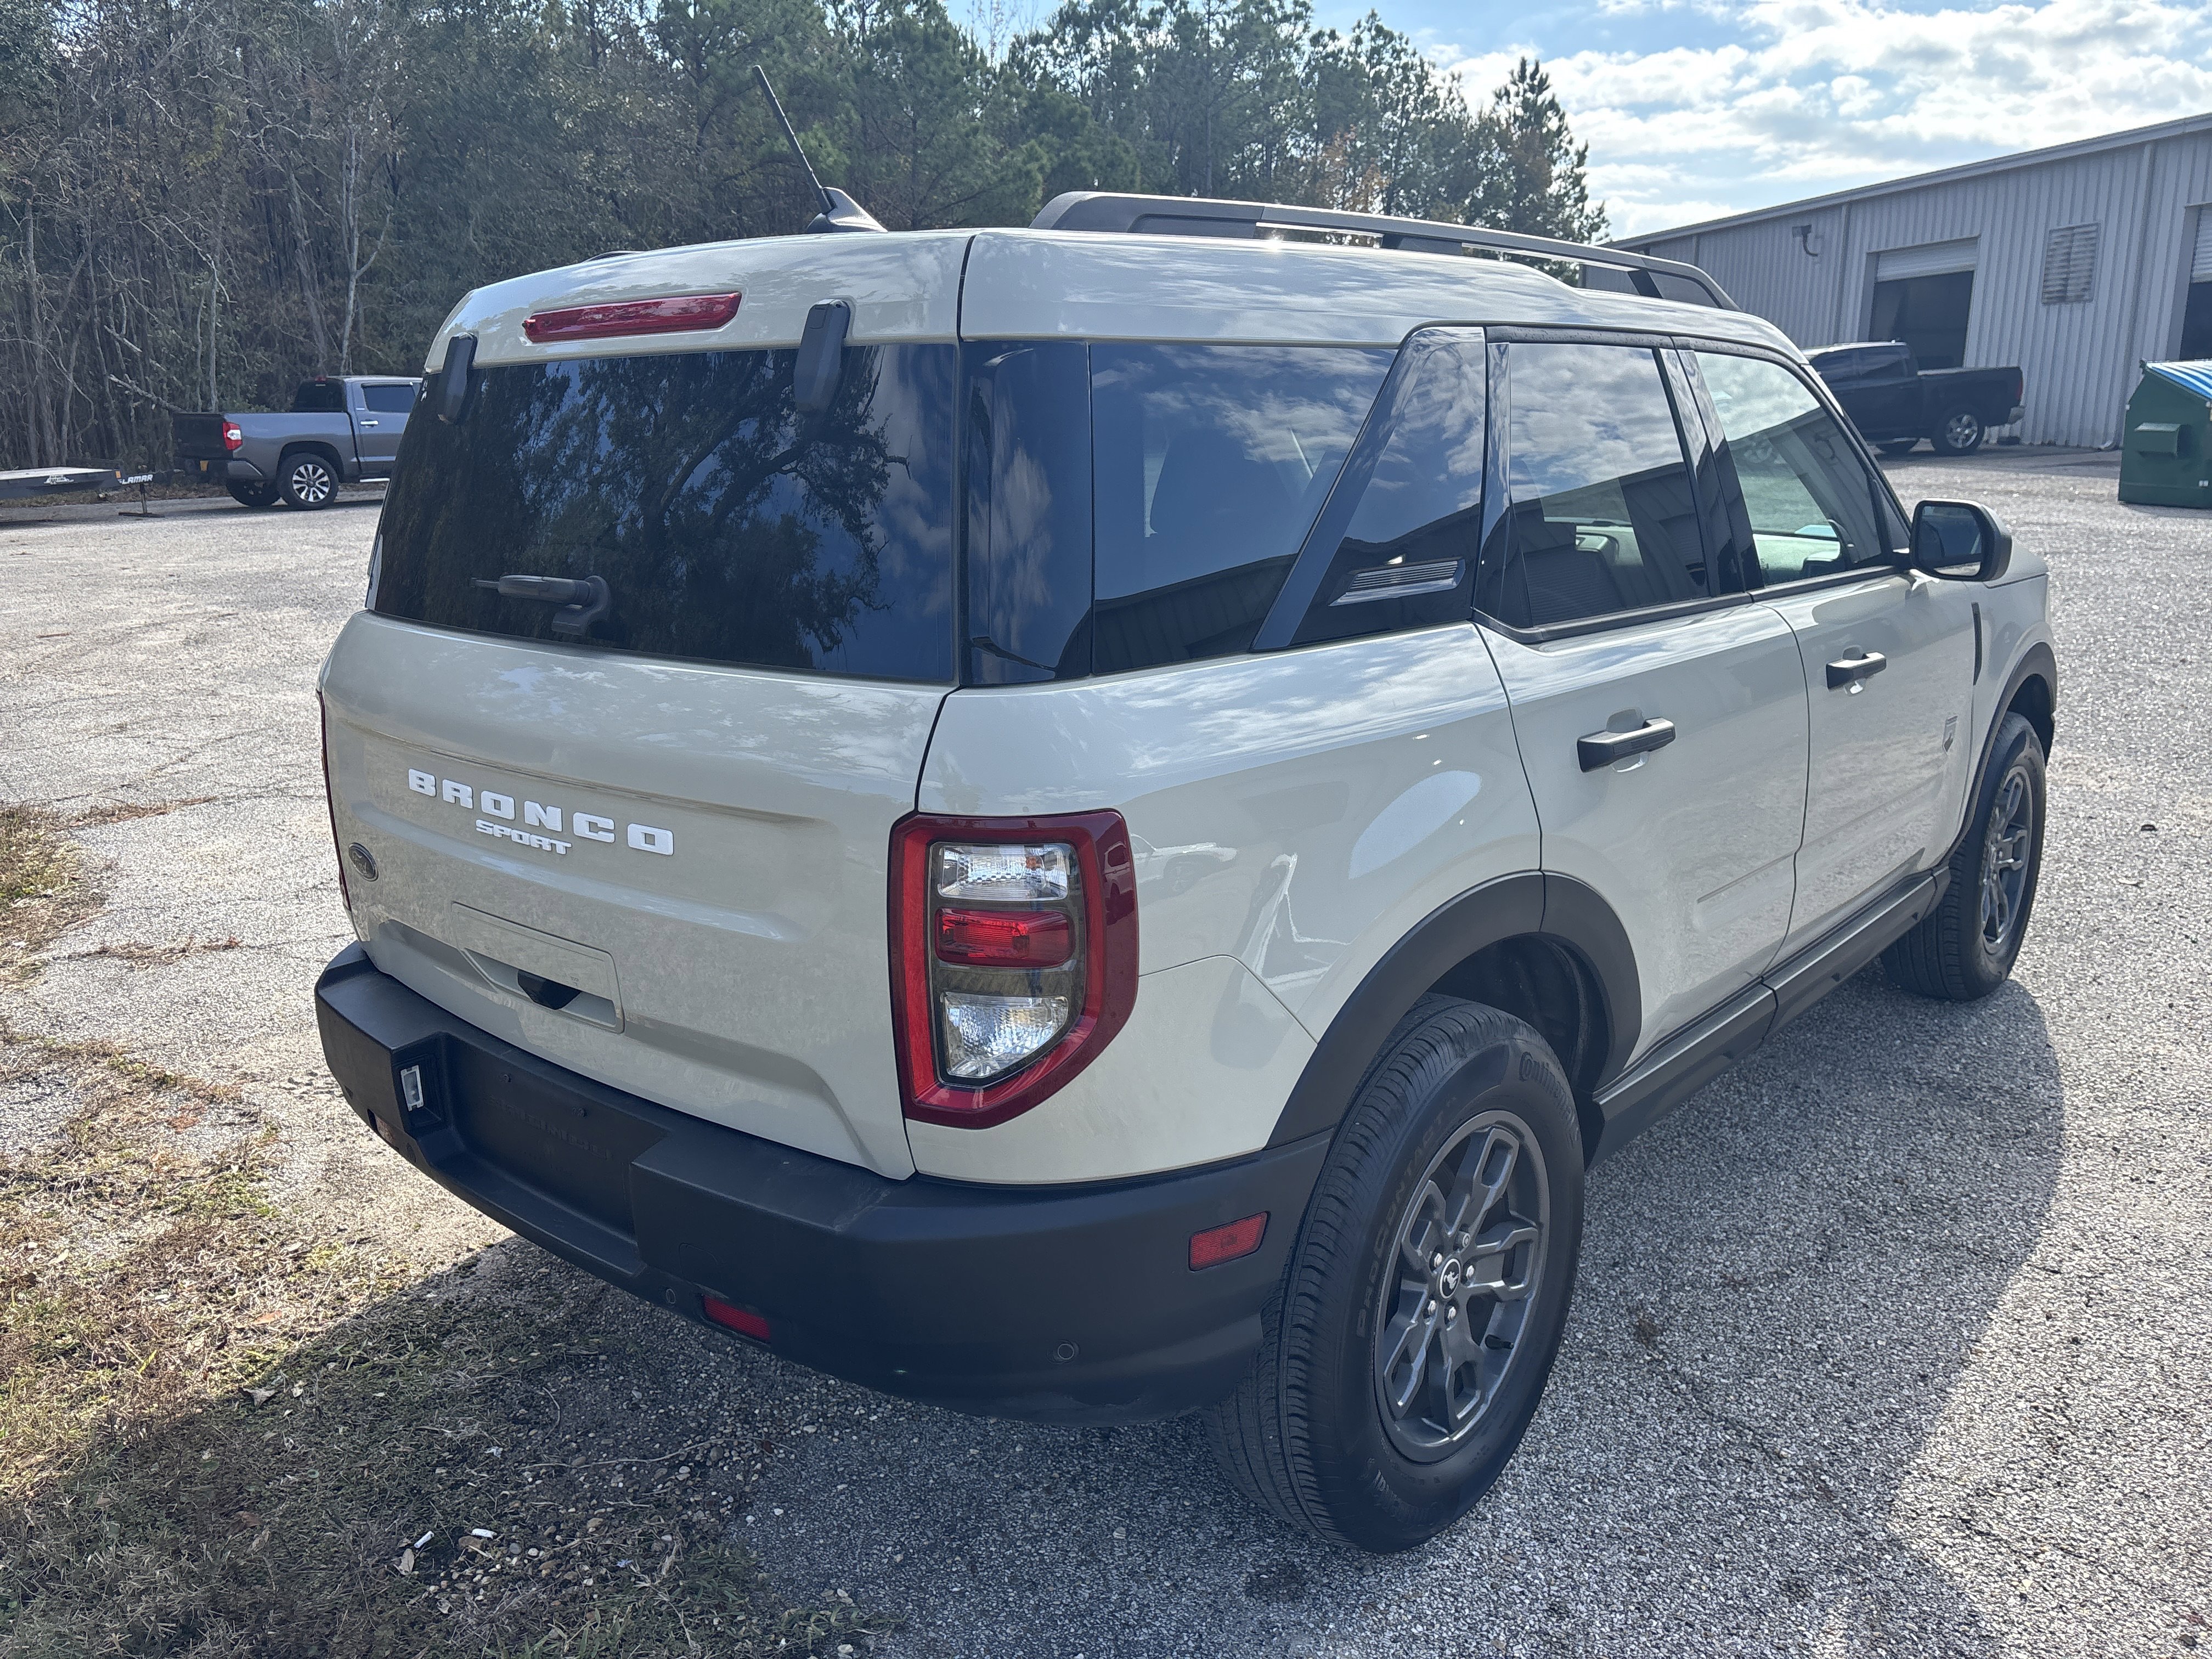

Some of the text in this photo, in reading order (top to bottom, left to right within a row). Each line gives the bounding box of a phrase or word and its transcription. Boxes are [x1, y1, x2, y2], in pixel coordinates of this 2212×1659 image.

[122, 474, 153, 484] LAMAR
[409, 769, 674, 855] BRONCO
[476, 820, 572, 855] SPORT
